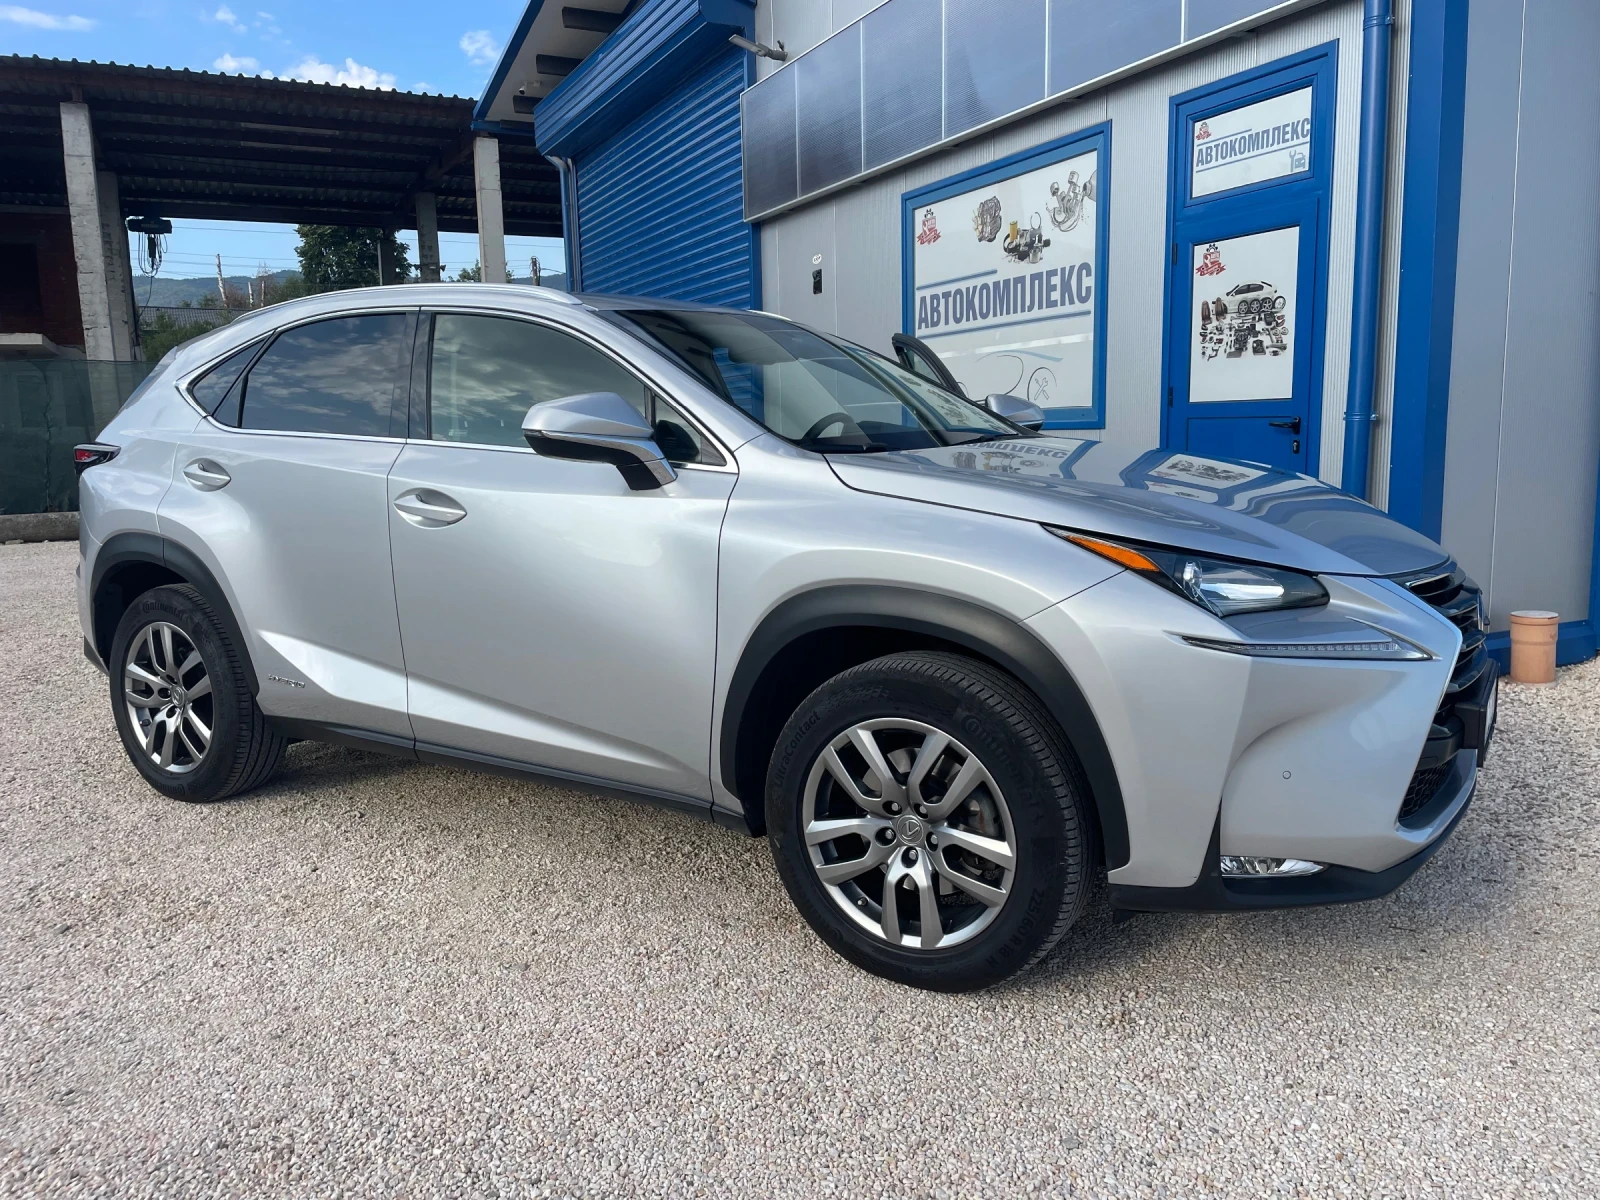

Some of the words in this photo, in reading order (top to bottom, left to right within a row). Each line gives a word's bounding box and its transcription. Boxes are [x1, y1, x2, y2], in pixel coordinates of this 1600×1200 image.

[1196, 118, 1310, 167] АВТОКОМПЛЕКС
[918, 262, 1092, 330] АВТОКОМПЛЕКС
[774, 709, 821, 788] UltraContact
